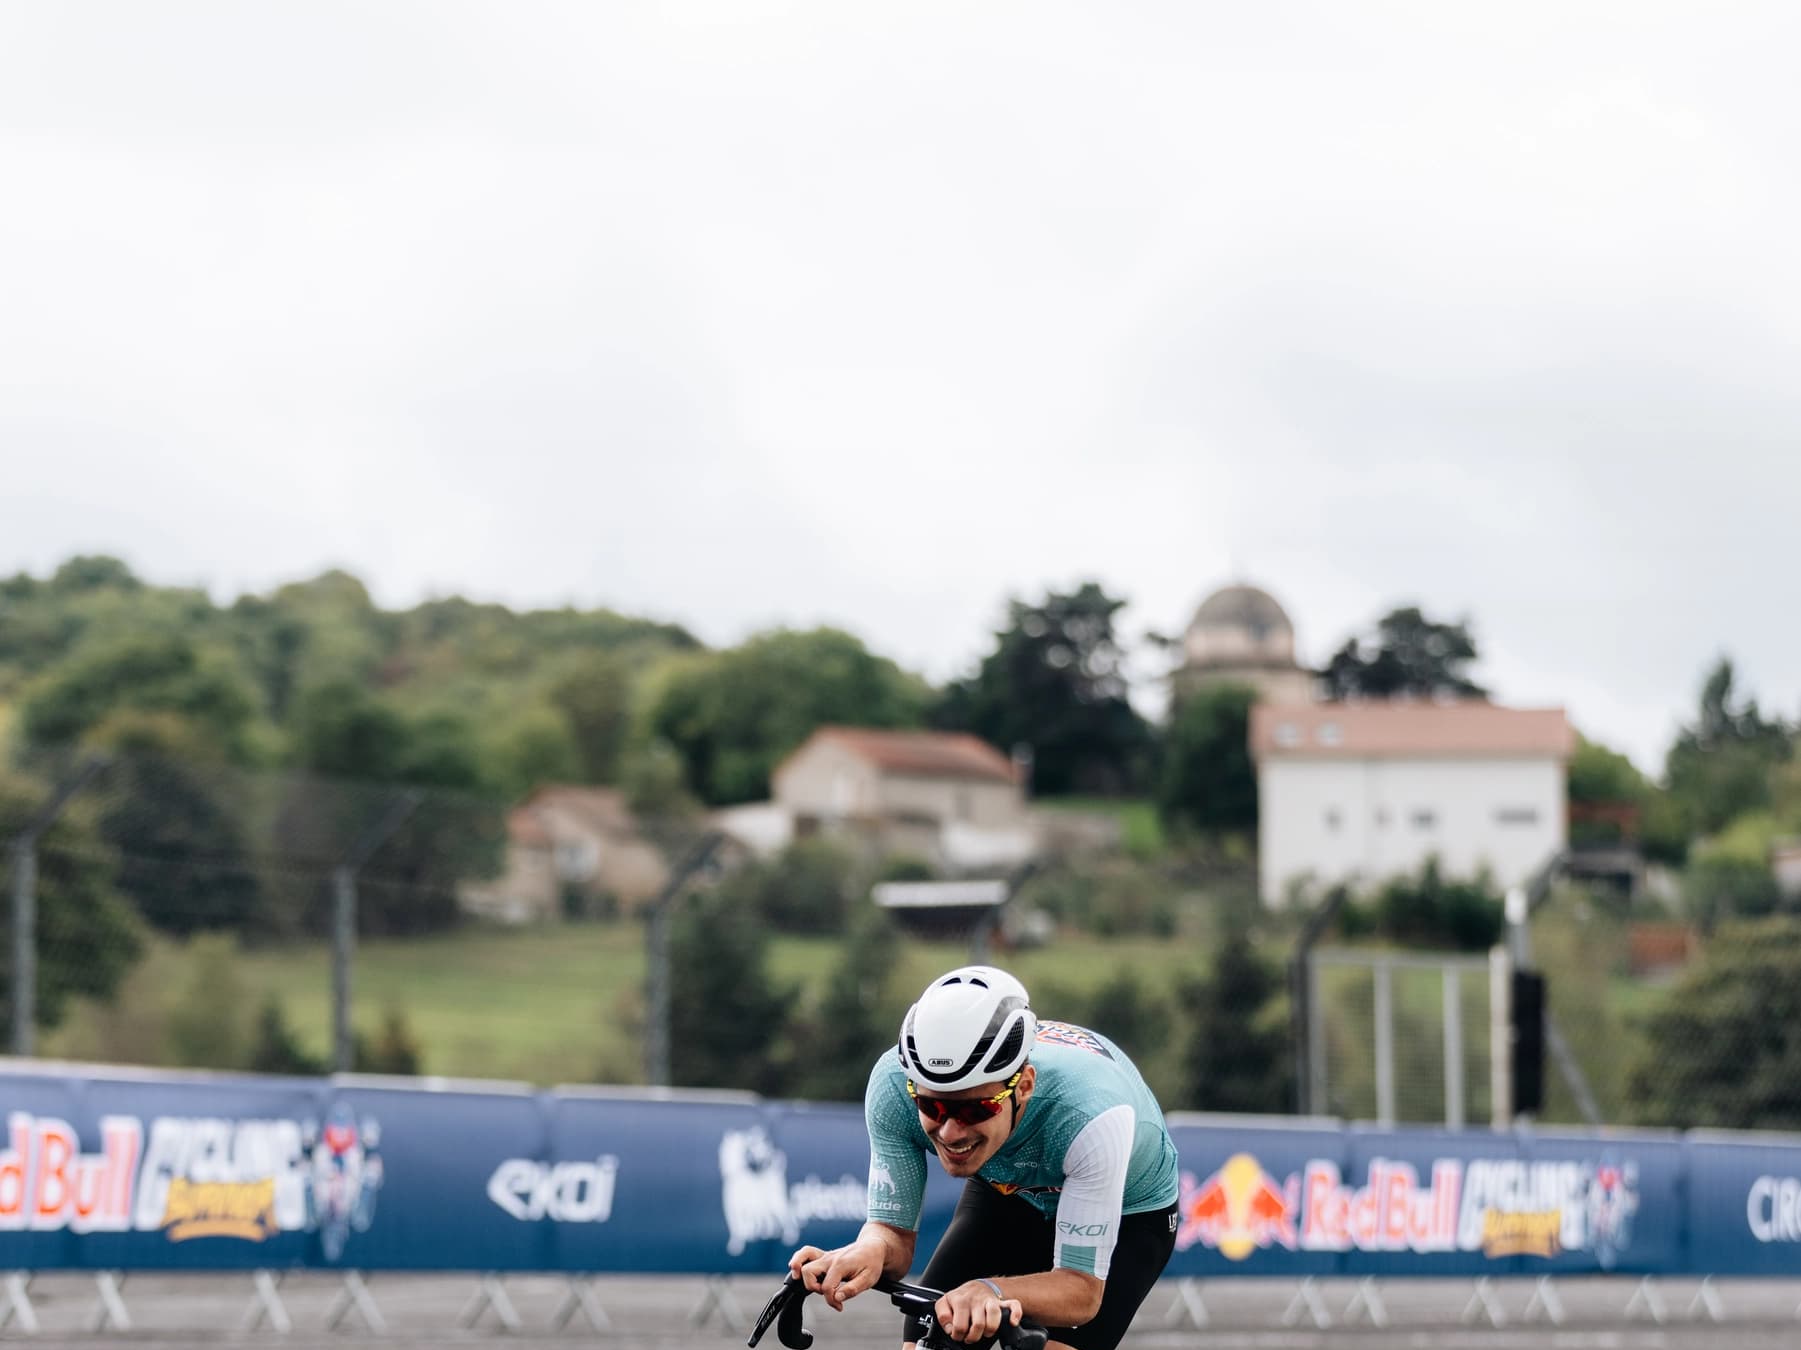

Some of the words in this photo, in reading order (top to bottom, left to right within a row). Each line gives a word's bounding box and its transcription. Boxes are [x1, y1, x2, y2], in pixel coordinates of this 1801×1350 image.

[31, 1118, 142, 1230] Bull
[1303, 1162, 1385, 1248] Red
[1384, 1161, 1465, 1250] Bull
[1747, 1175, 1801, 1243] CIR
